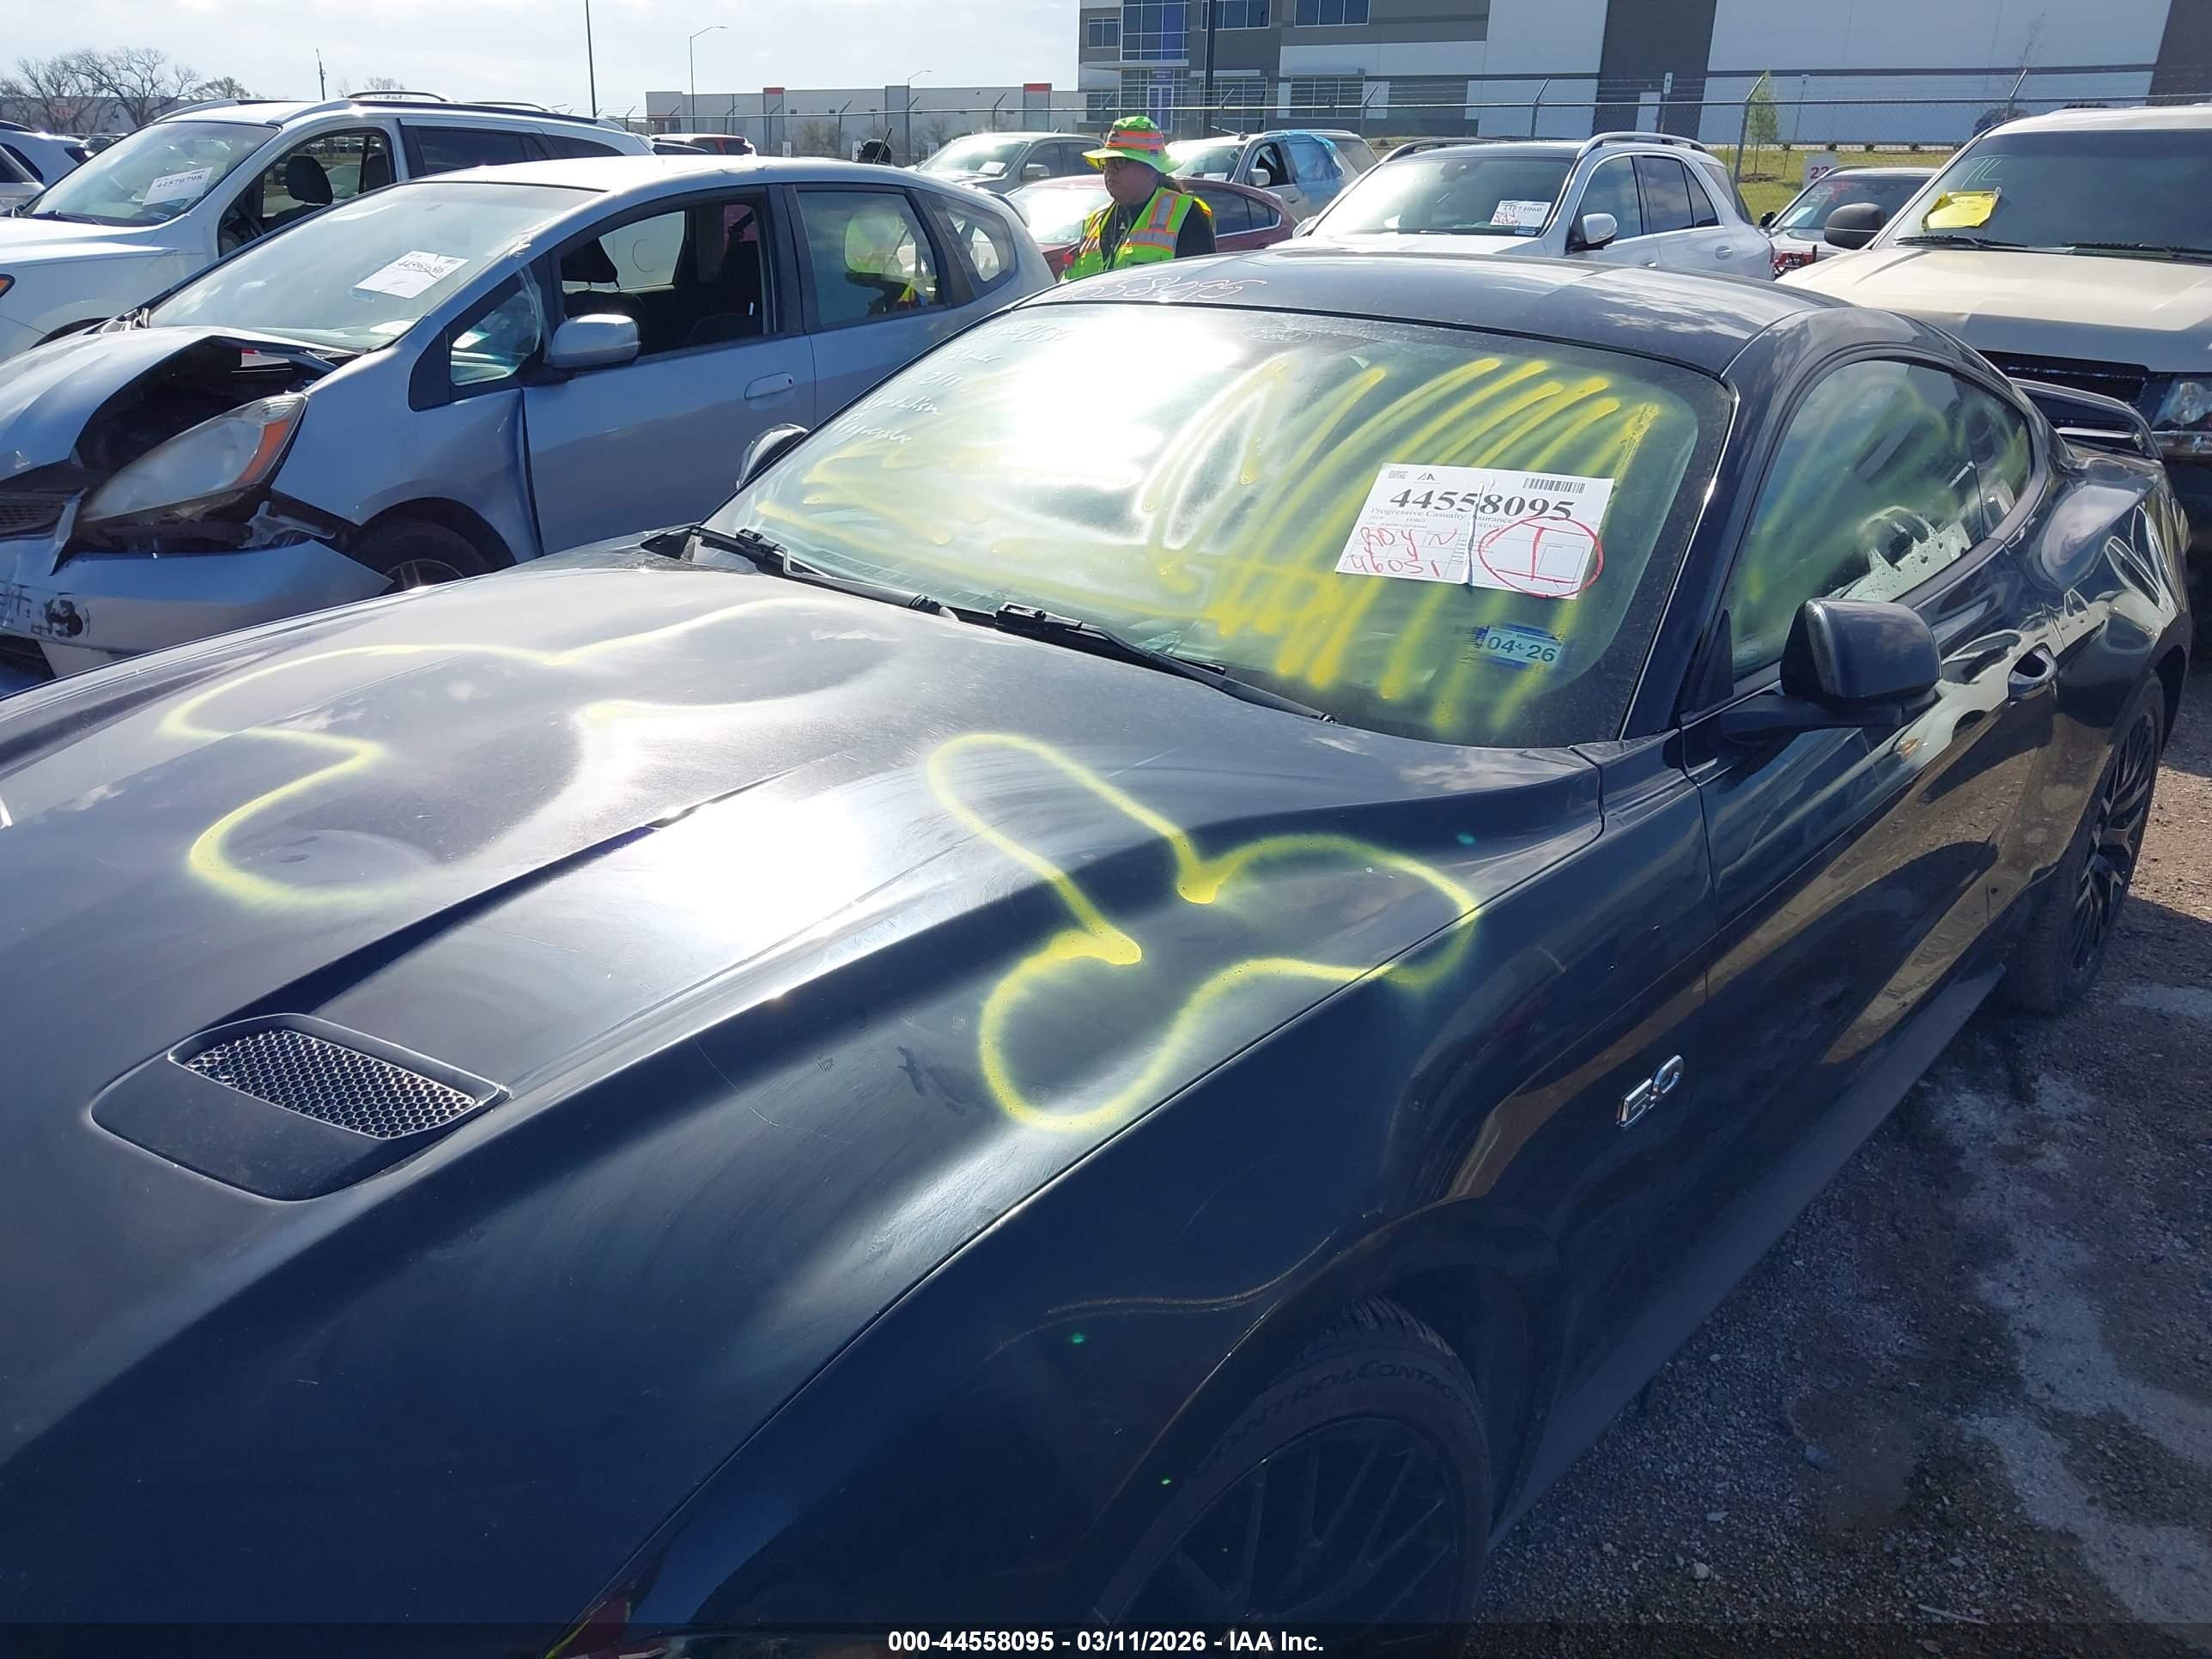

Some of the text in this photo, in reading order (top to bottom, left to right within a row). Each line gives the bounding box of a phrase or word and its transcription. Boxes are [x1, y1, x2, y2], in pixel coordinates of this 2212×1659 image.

[1370, 507, 1425, 517] Progressive
[1426, 510, 1467, 520] Casualty
[1389, 489, 1575, 520] 44558095
[1487, 636, 1516, 653] 04
[1525, 644, 1556, 663] 26
